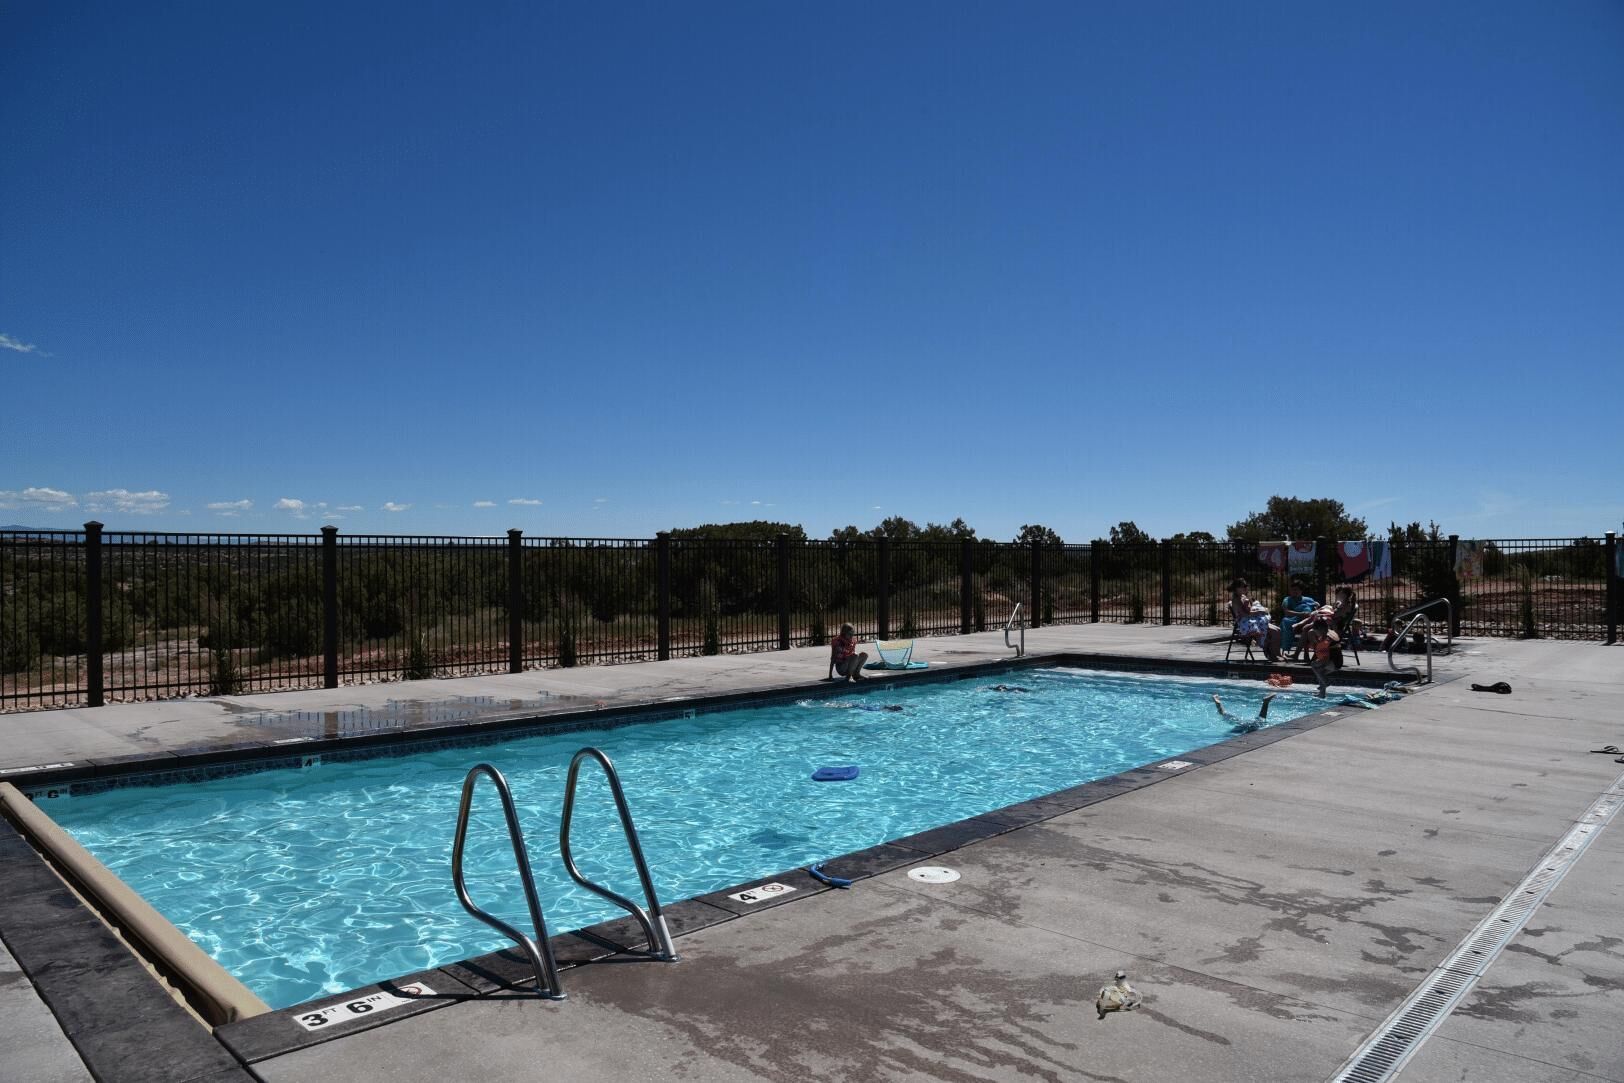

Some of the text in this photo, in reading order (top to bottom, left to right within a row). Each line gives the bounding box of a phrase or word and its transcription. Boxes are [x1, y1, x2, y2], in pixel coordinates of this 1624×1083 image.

[739, 893, 758, 901] 4
[301, 995, 383, 1027] 3 FT 6 IN
